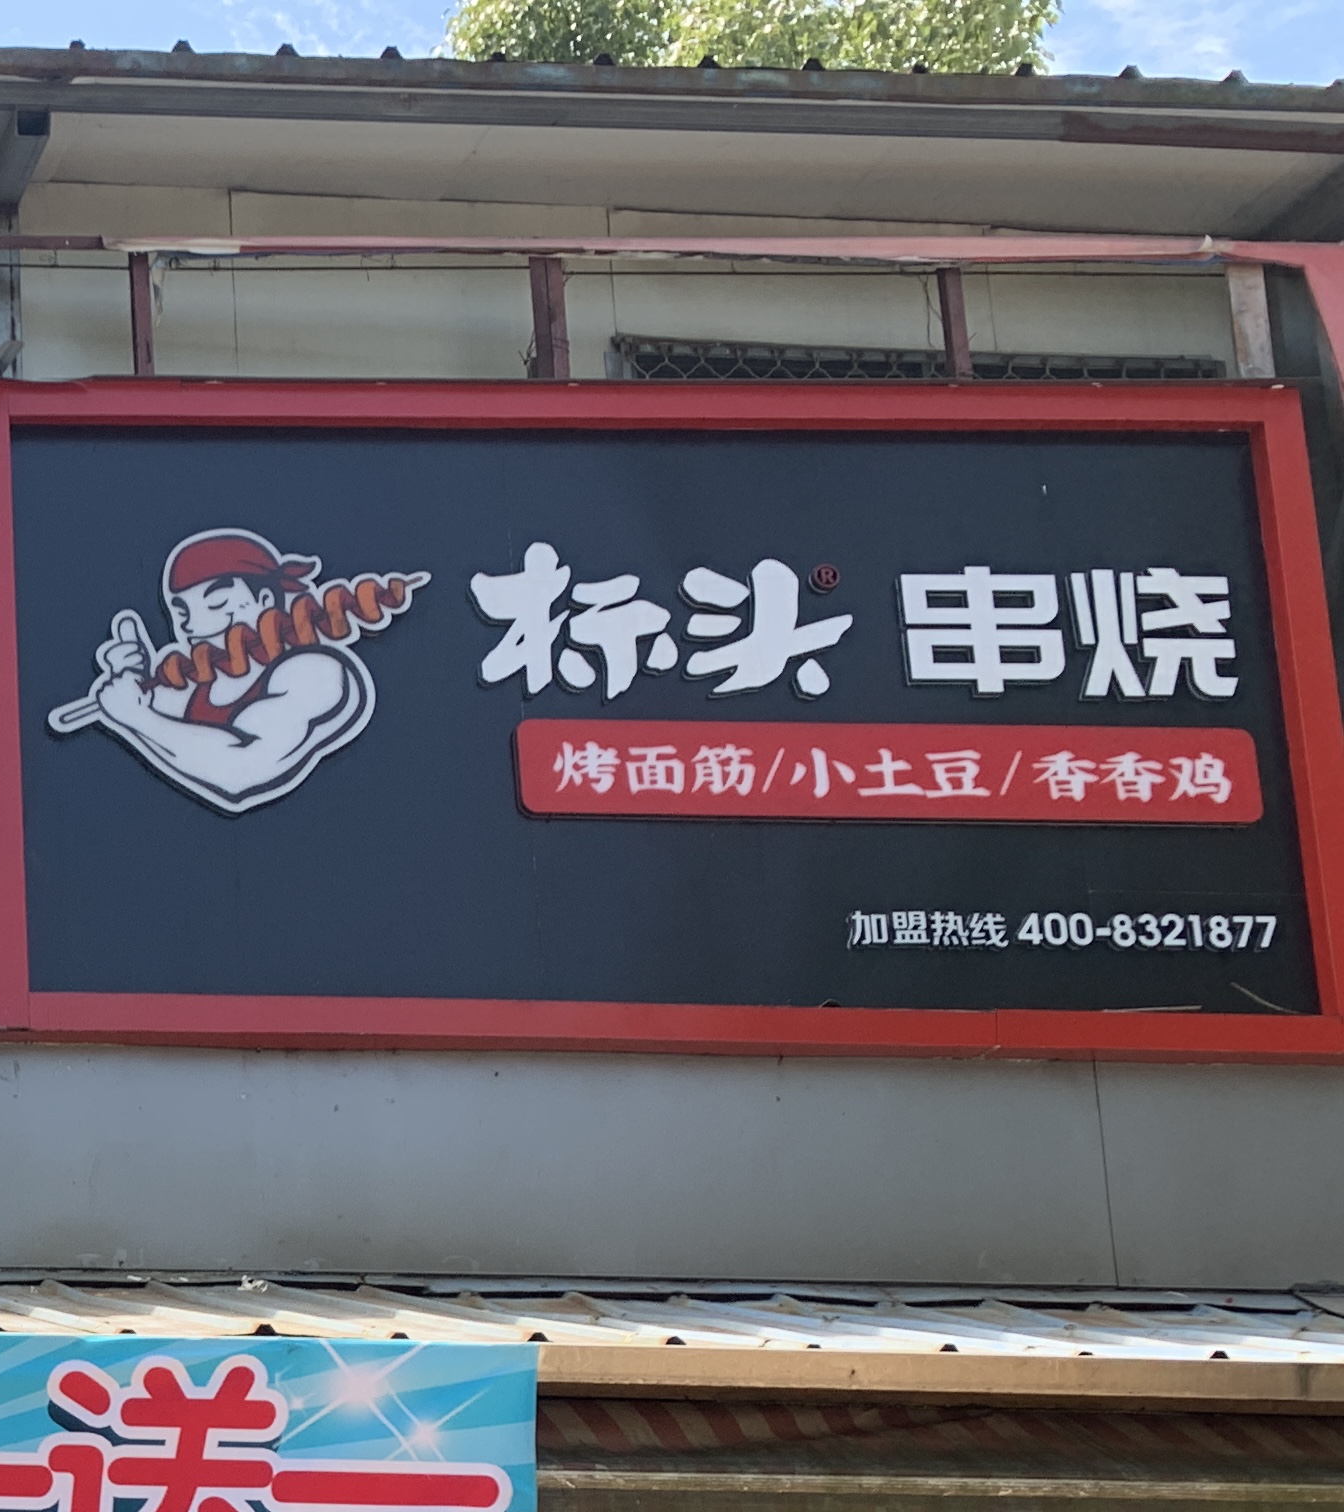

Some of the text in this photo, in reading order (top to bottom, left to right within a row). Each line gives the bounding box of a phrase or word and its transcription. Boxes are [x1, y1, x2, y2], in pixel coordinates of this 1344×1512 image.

[469, 542, 1239, 701] 标头 串烧
[553, 741, 1232, 804] 烤面筋/小土豆/香香鸡
[850, 910, 1277, 949] 加盟热线 400-8321877
